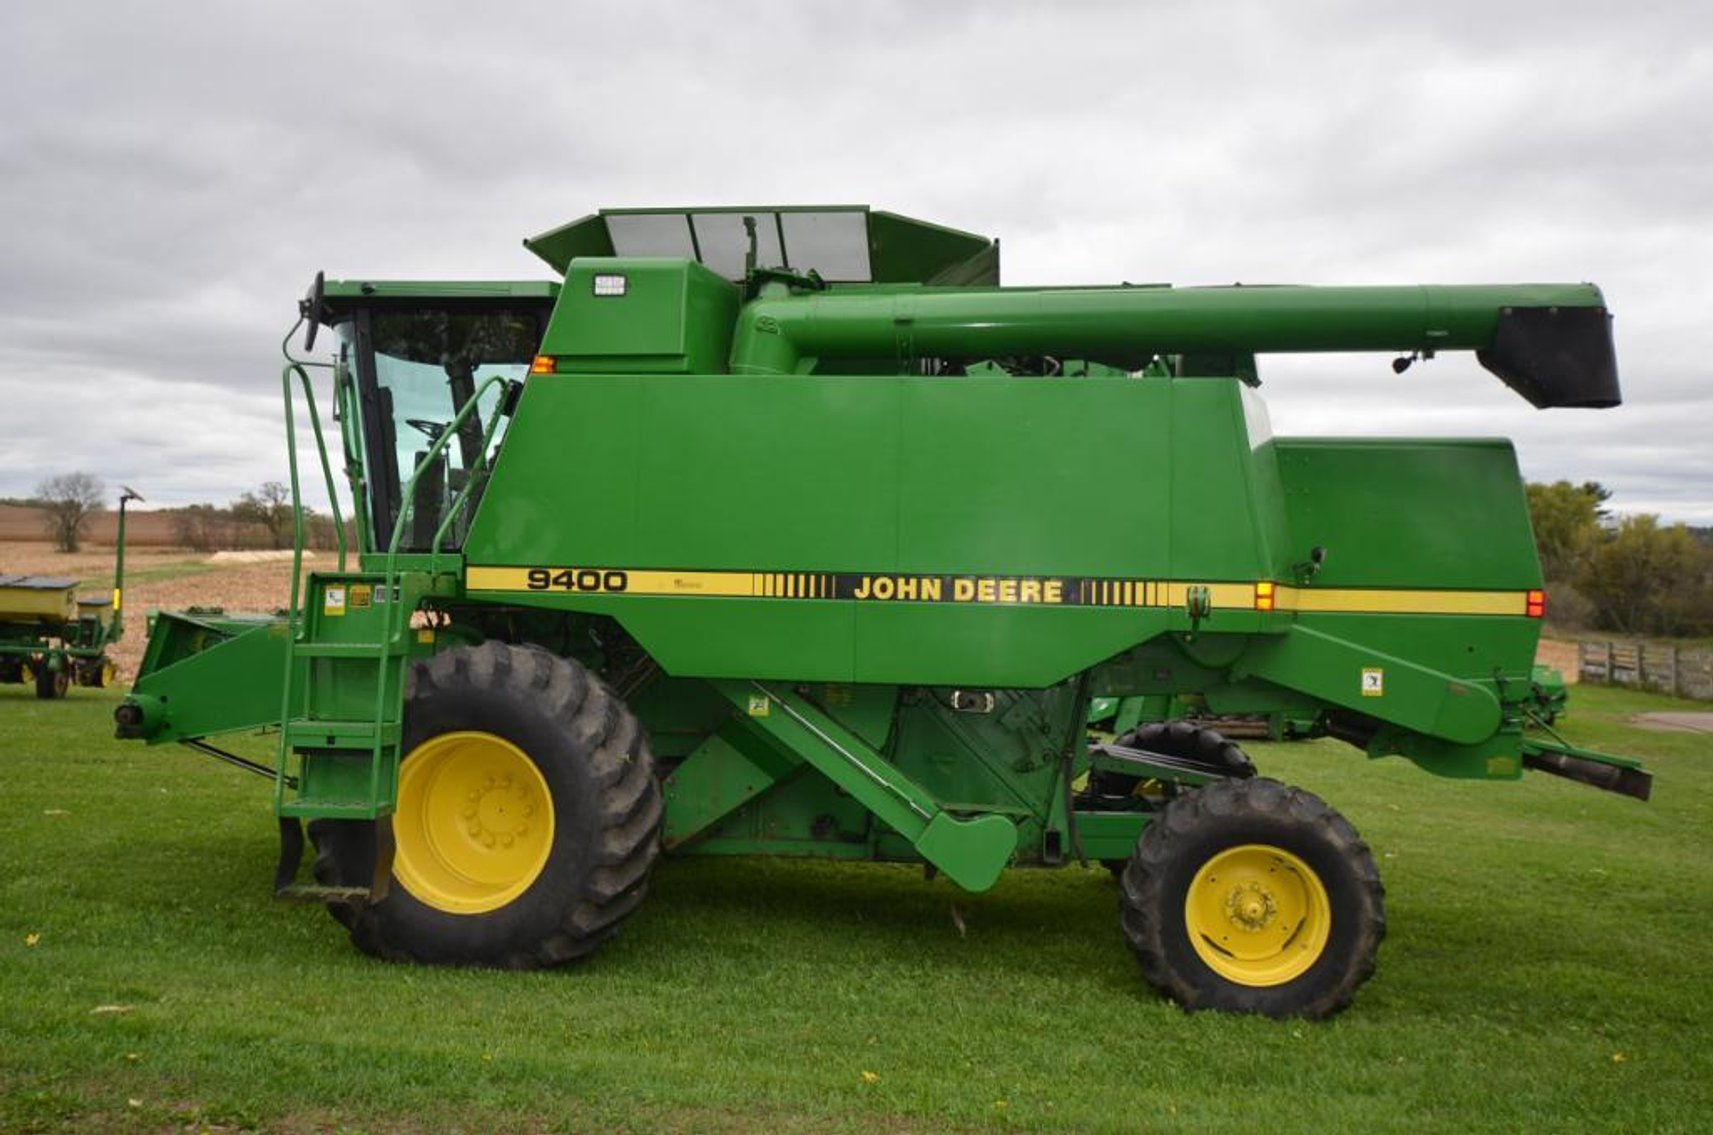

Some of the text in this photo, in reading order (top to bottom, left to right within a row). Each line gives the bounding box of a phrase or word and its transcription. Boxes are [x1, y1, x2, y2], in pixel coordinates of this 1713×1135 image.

[527, 569, 628, 592] 9400
[854, 576, 1063, 603] JOHN DEERE
